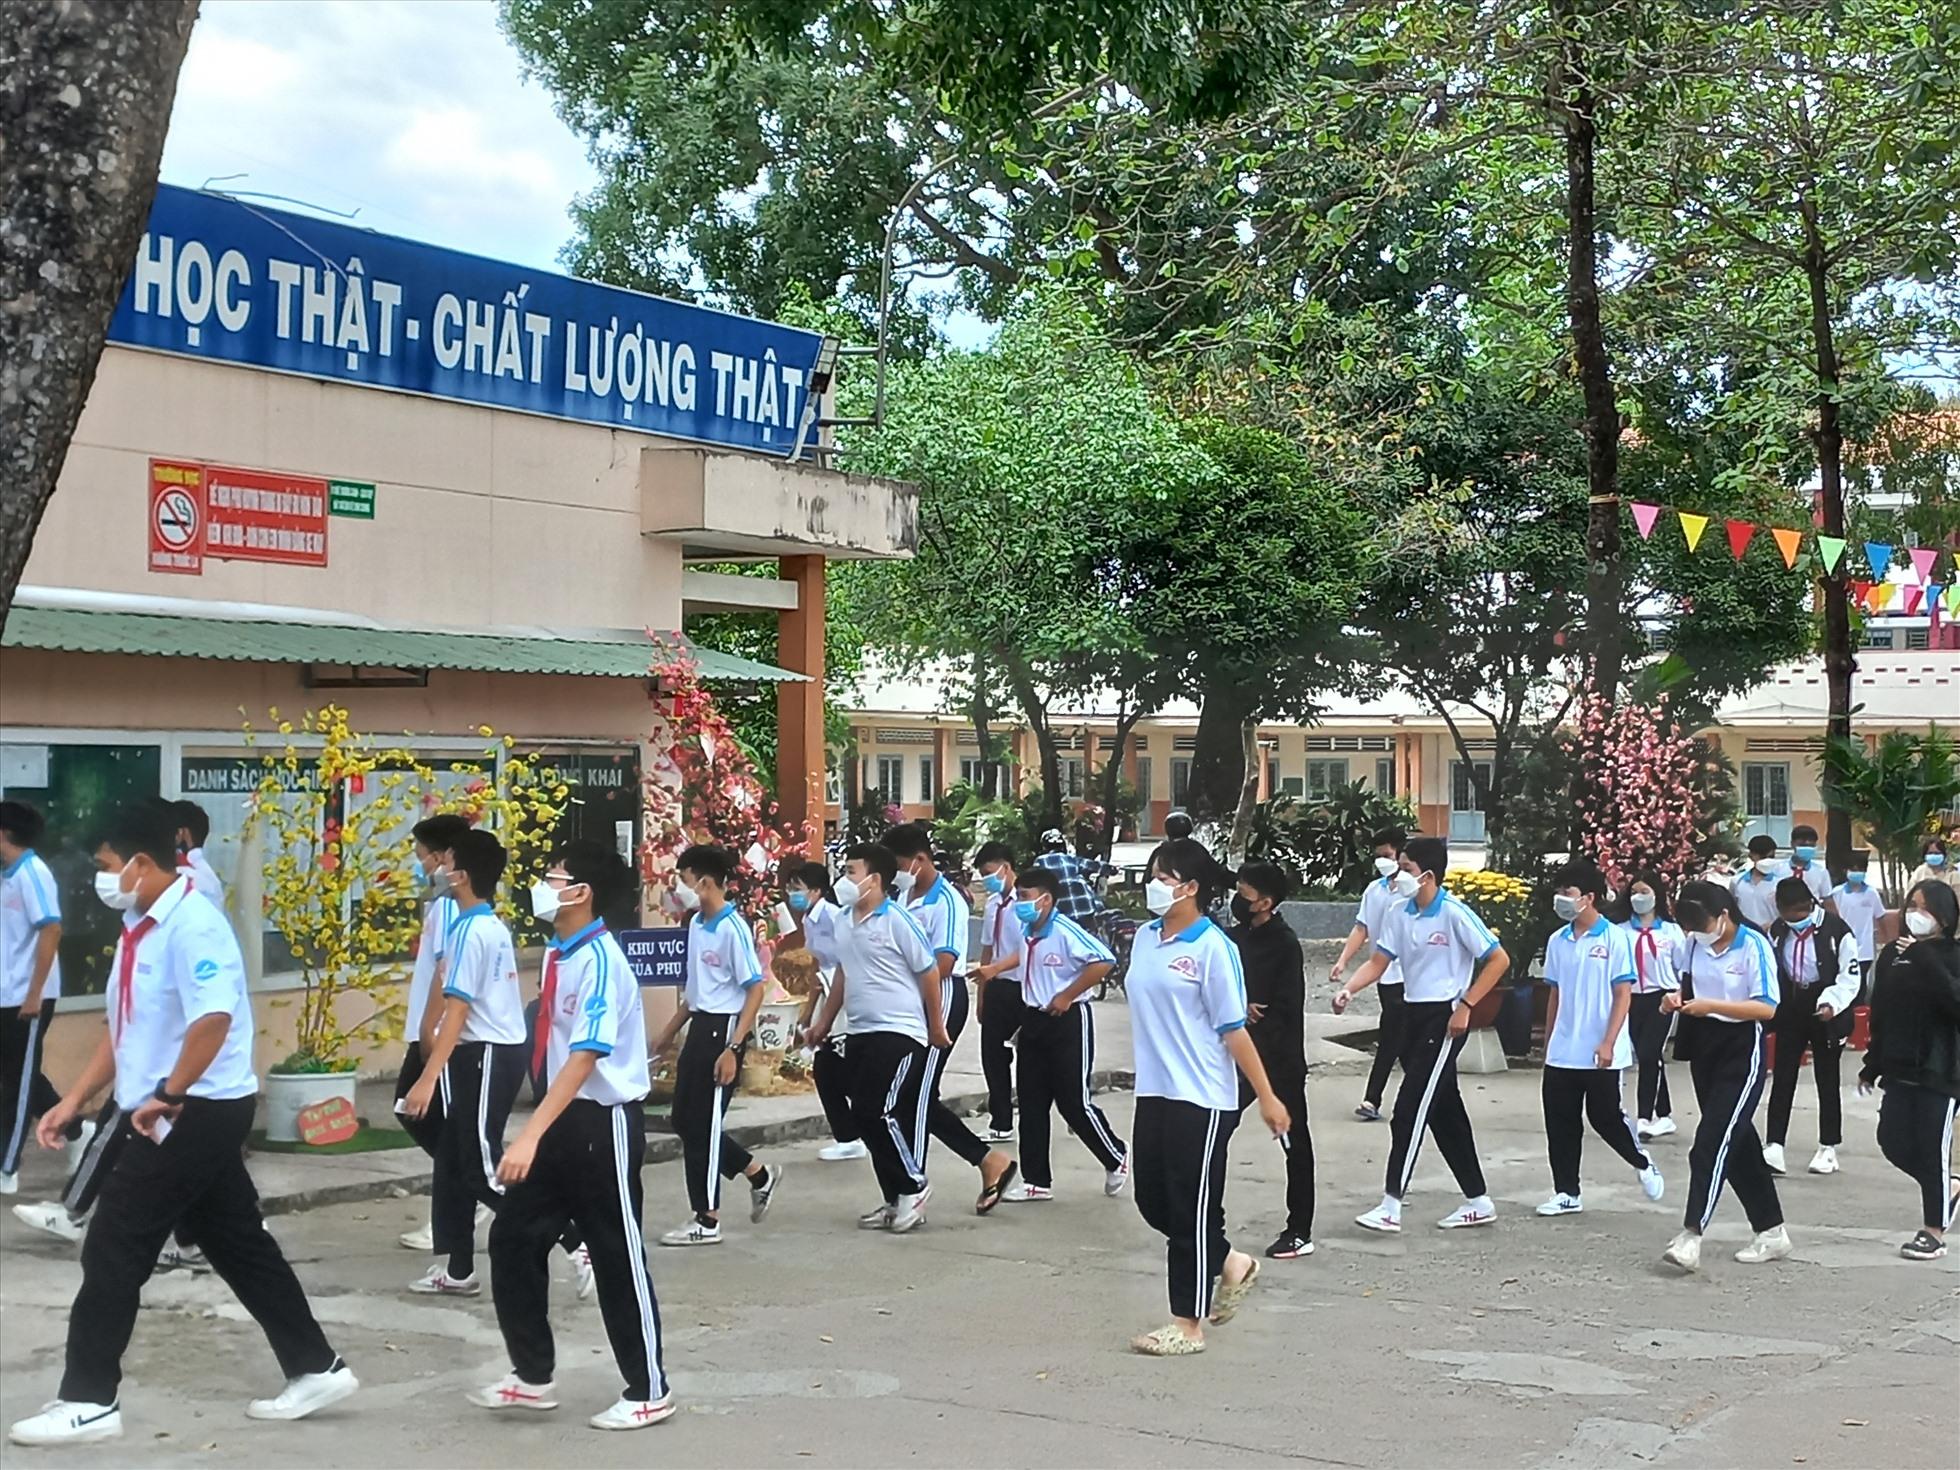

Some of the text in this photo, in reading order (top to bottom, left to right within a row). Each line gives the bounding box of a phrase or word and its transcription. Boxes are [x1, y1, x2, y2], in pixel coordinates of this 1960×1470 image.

[134, 232, 252, 347] HỌC
[268, 257, 402, 371] THẬT
[433, 283, 551, 384] CHẤT
[564, 316, 697, 421] LƯỢNG
[710, 347, 803, 443] THẬT
[188, 768, 228, 790] DANH
[588, 769, 622, 787] KHAI
[627, 939, 685, 957] KHU VỰC
[656, 961, 682, 978] PHỤ
